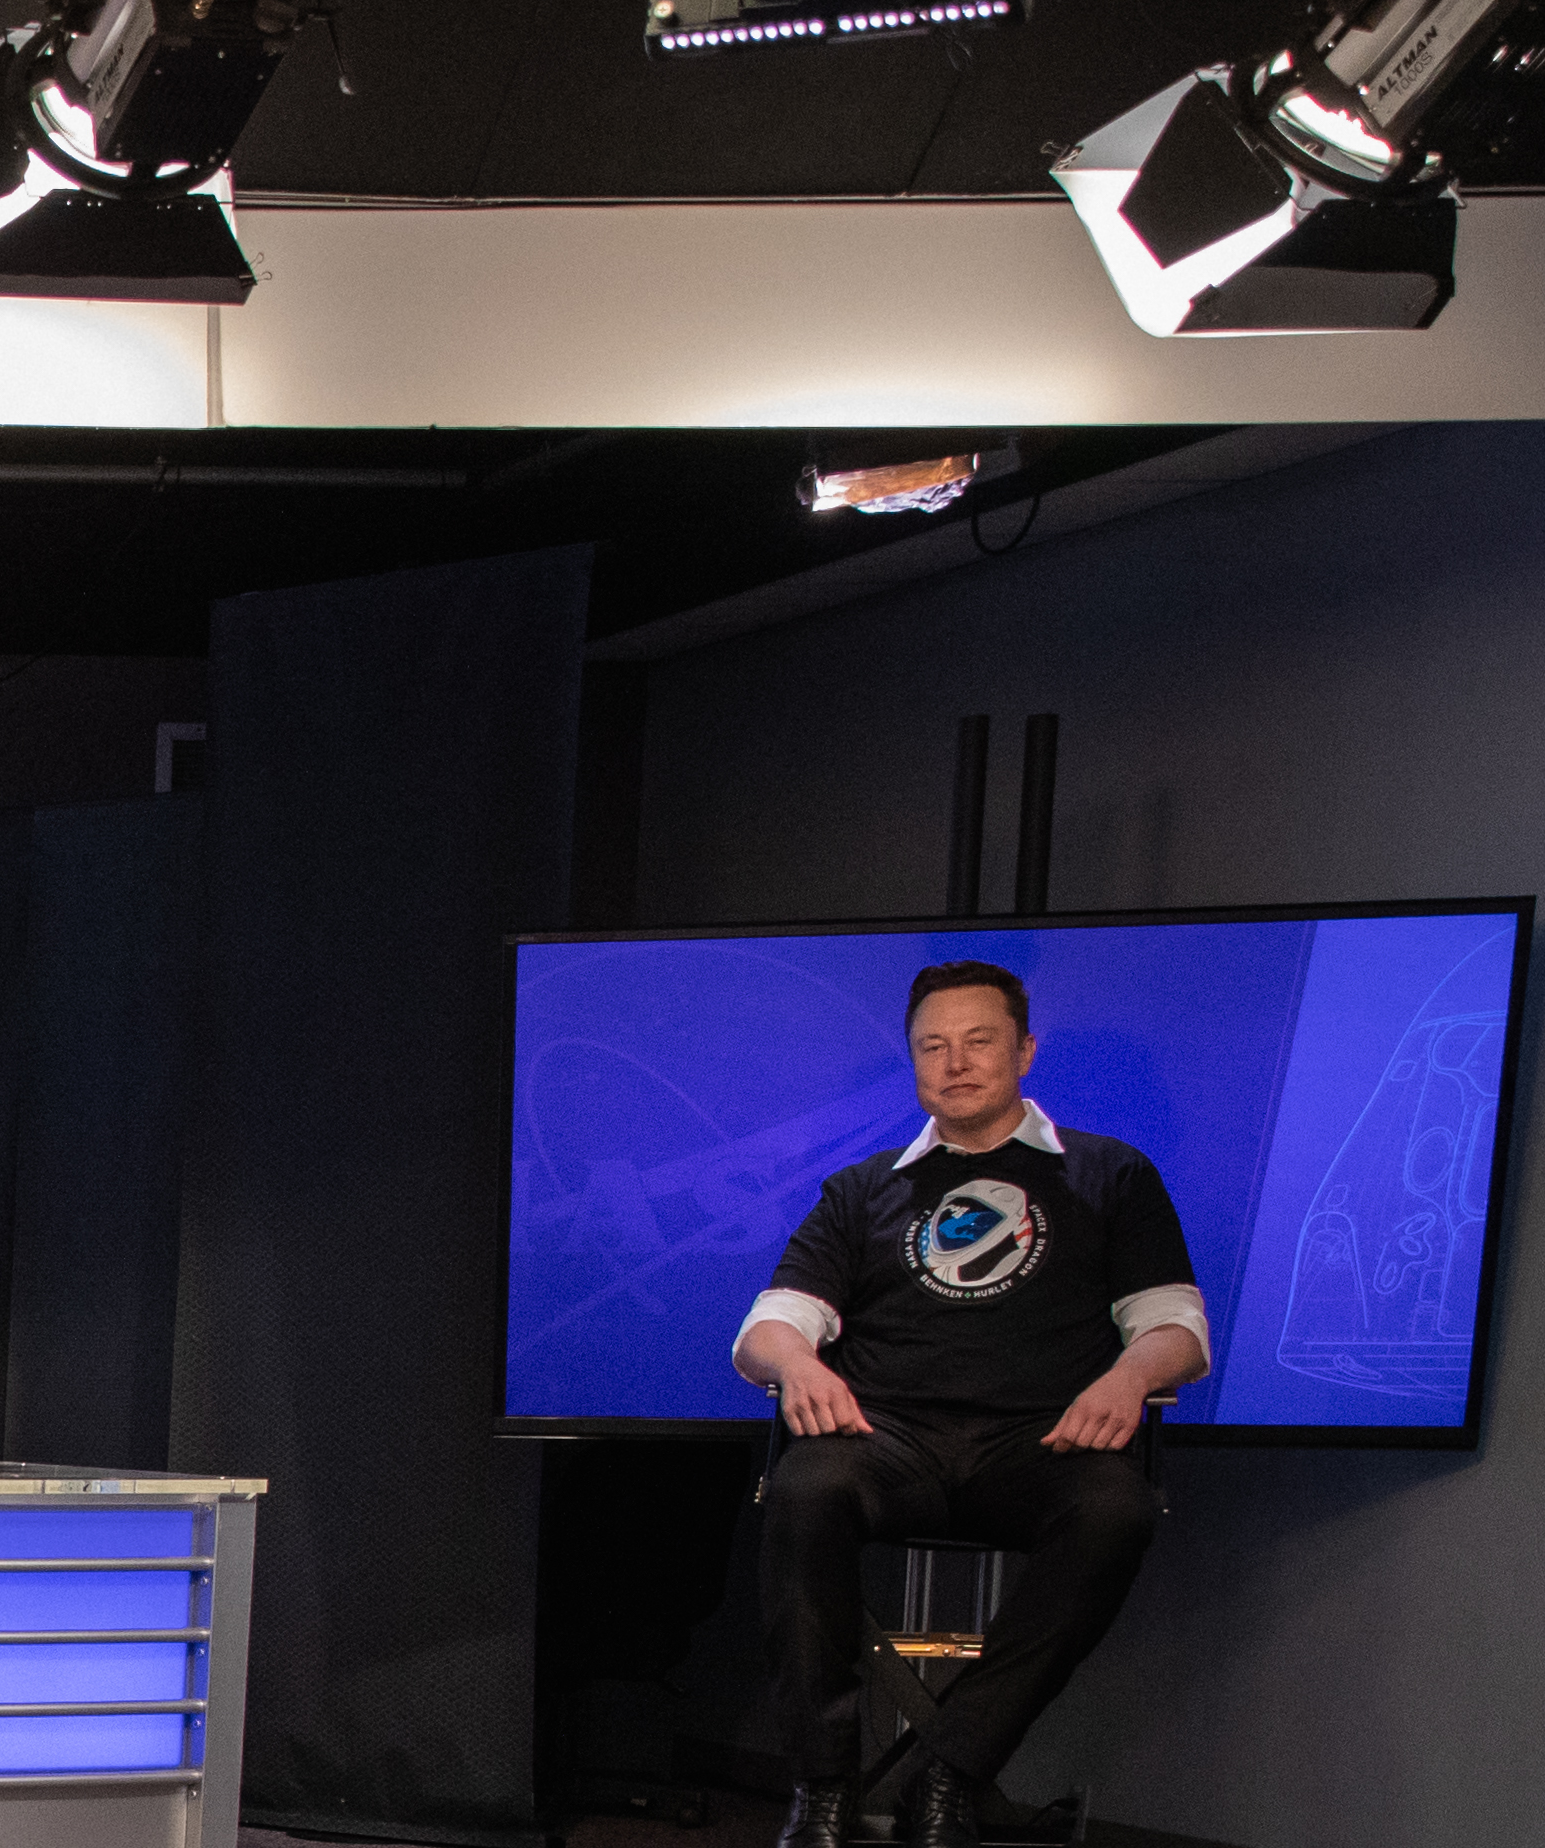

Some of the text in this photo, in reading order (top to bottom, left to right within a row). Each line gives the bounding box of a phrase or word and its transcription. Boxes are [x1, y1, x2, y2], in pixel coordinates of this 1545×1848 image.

[1377, 25, 1438, 100] ALTMAN
[904, 1220, 921, 1243] DEMO
[1018, 1204, 1047, 1277] SPACEX DRAGON
[904, 1244, 919, 1269] NASA
[919, 1273, 1013, 1299] BEHNKEN HURLEY
